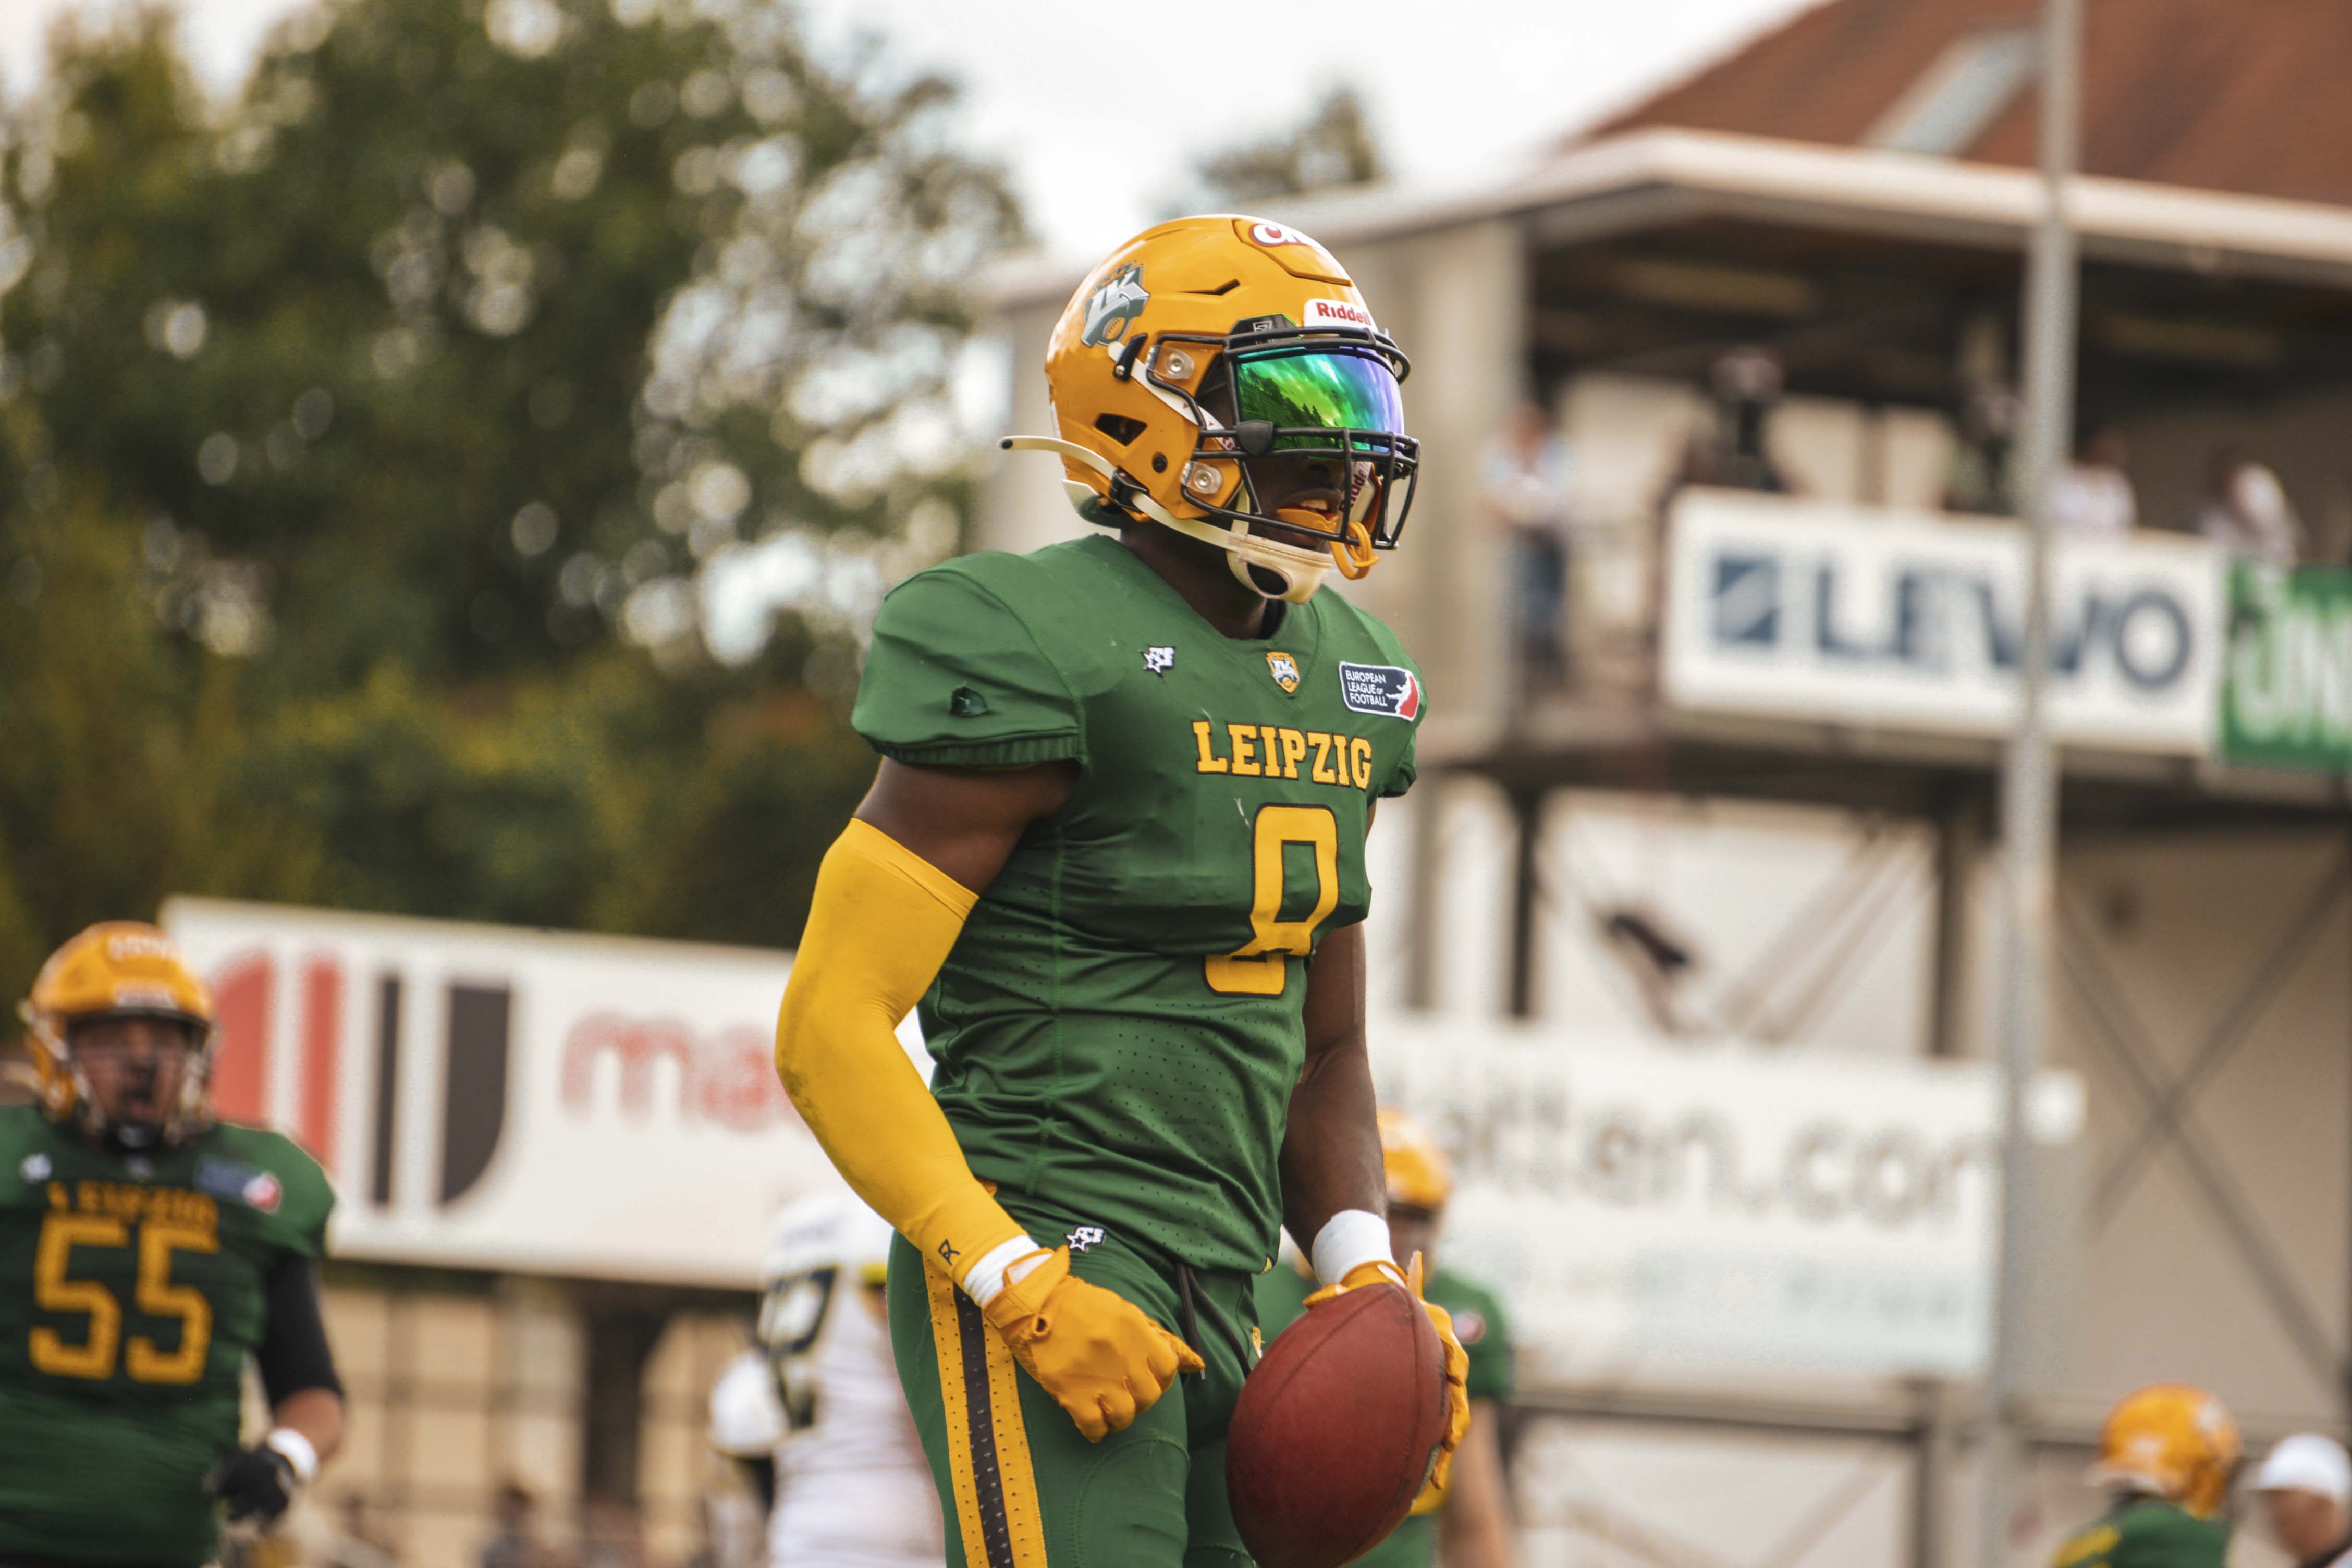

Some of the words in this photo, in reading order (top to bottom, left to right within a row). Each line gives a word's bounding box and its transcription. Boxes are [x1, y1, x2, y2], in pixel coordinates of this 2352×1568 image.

[1315, 302, 1372, 326] Riddell
[1345, 670, 1387, 683] EUROPEAN
[1348, 681, 1376, 694] LEAGUE
[1350, 692, 1388, 707] FOOTBALL
[1192, 720, 1373, 791] LEIPZIG
[28, 1214, 221, 1387] 55
